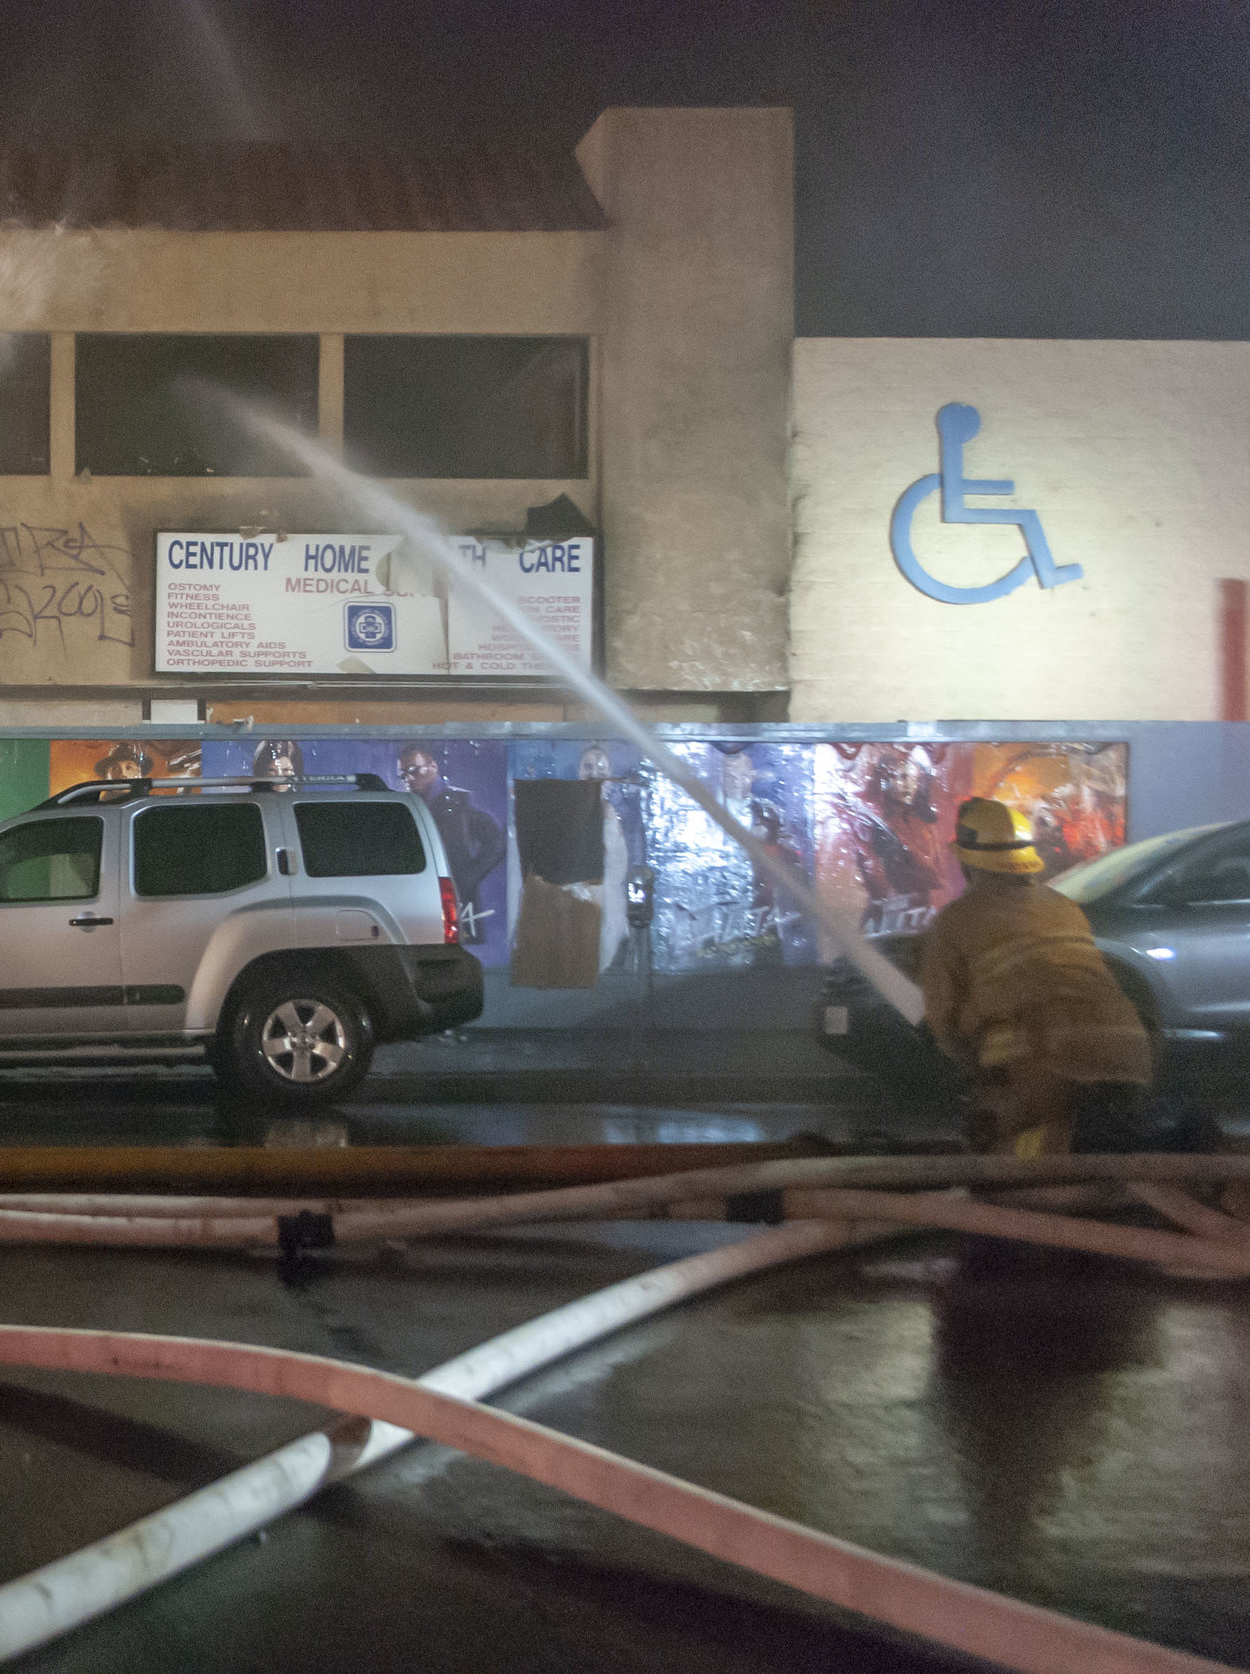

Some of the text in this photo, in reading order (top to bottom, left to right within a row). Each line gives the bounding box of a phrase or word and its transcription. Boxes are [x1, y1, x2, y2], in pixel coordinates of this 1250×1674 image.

[168, 540, 274, 571] CENTURY
[304, 543, 372, 573] HOME
[519, 544, 581, 573] CARE
[168, 583, 222, 592] OSTOMY
[285, 578, 375, 594] MEDICAL
[167, 592, 220, 601] FITNESS
[517, 596, 581, 604] SCOOTER
[168, 602, 250, 611] WHEELCHAIR
[167, 612, 252, 621] INCONTIENCE
[167, 621, 257, 630] UROLOGICALS
[167, 631, 255, 640] PATIENT LIFTS
[167, 641, 287, 650] AMBULATORY AIDS
[167, 649, 307, 659] VASCULAR SUPPORTS
[453, 653, 525, 661] BATHROOM
[167, 659, 314, 668] ORTHOPEDIC SUPPORT
[432, 662, 459, 670] HOT
[465, 662, 474, 670] &
[480, 662, 516, 670] COLD
